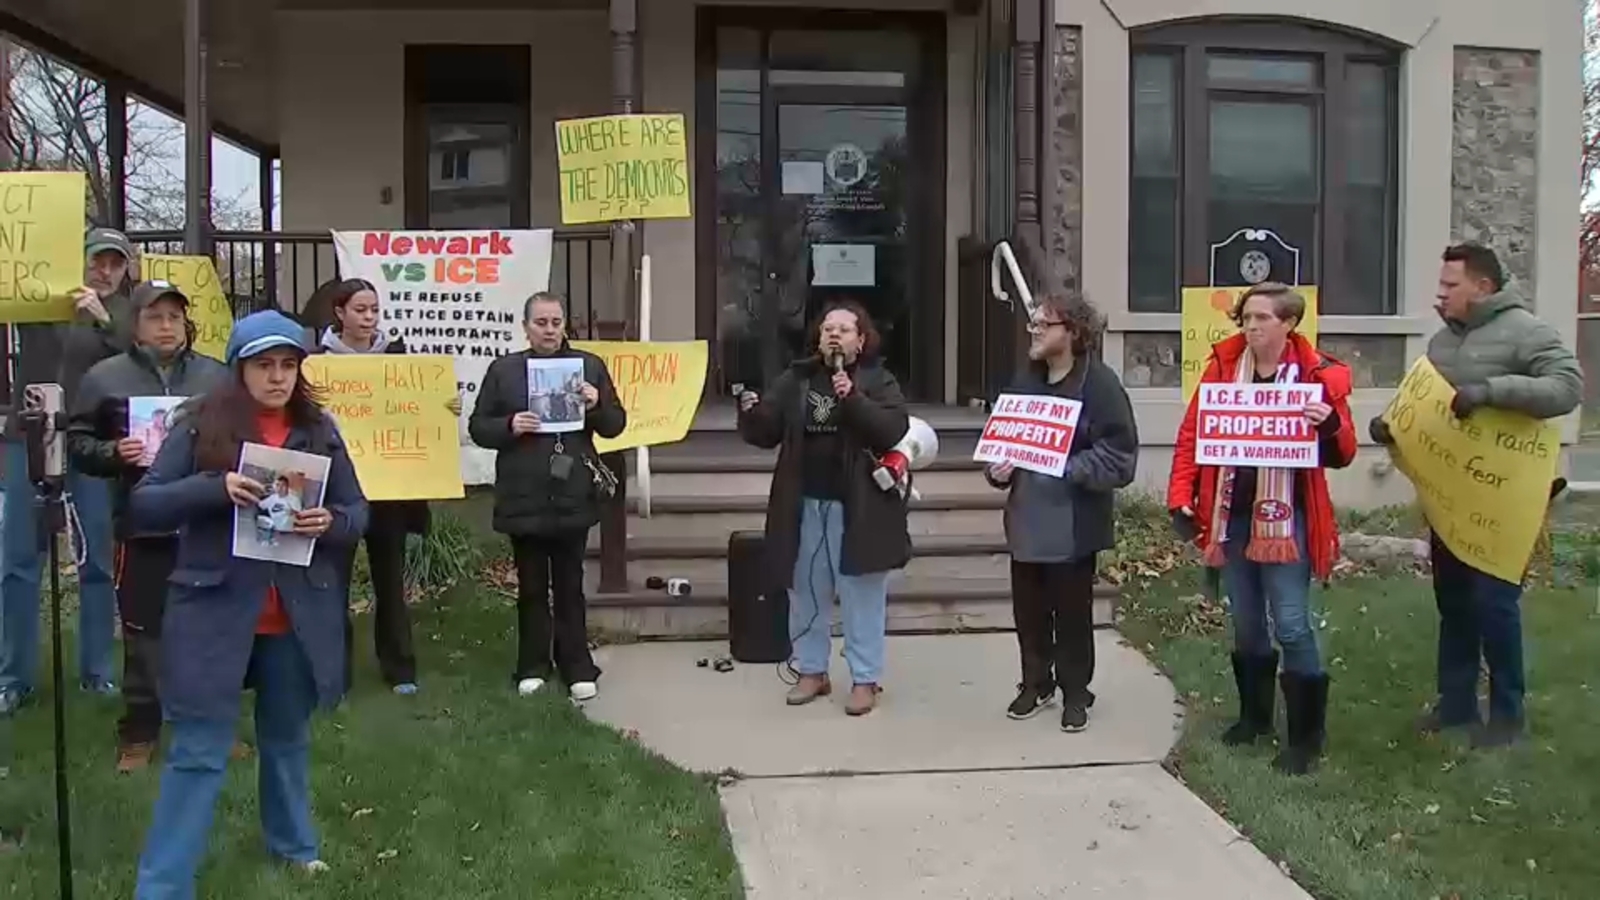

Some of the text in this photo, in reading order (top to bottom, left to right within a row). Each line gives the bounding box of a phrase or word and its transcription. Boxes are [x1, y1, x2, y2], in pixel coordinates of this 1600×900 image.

[559, 117, 681, 155] WHERE ARE
[560, 167, 598, 204] THE
[363, 232, 513, 256] Newark
[146, 258, 184, 288] ICE
[434, 258, 500, 284] ICE
[389, 291, 484, 304] WE REFUSE
[383, 309, 514, 324] LET ICE DETAIN
[403, 327, 513, 343] IMMIGRANTS
[1206, 389, 1314, 406] I.C.E. OFF MY
[998, 399, 1073, 421] I.C.E. OFF MY
[1404, 362, 1434, 401] NO
[1495, 429, 1549, 459] raids
[986, 420, 1067, 448] PROPERTY
[1204, 414, 1308, 437] PROPERTY
[980, 444, 1060, 469] GET A WARRANT!
[1203, 445, 1311, 460] GET A WARRANT!
[1463, 456, 1509, 490] fear
[1469, 511, 1501, 534] are
